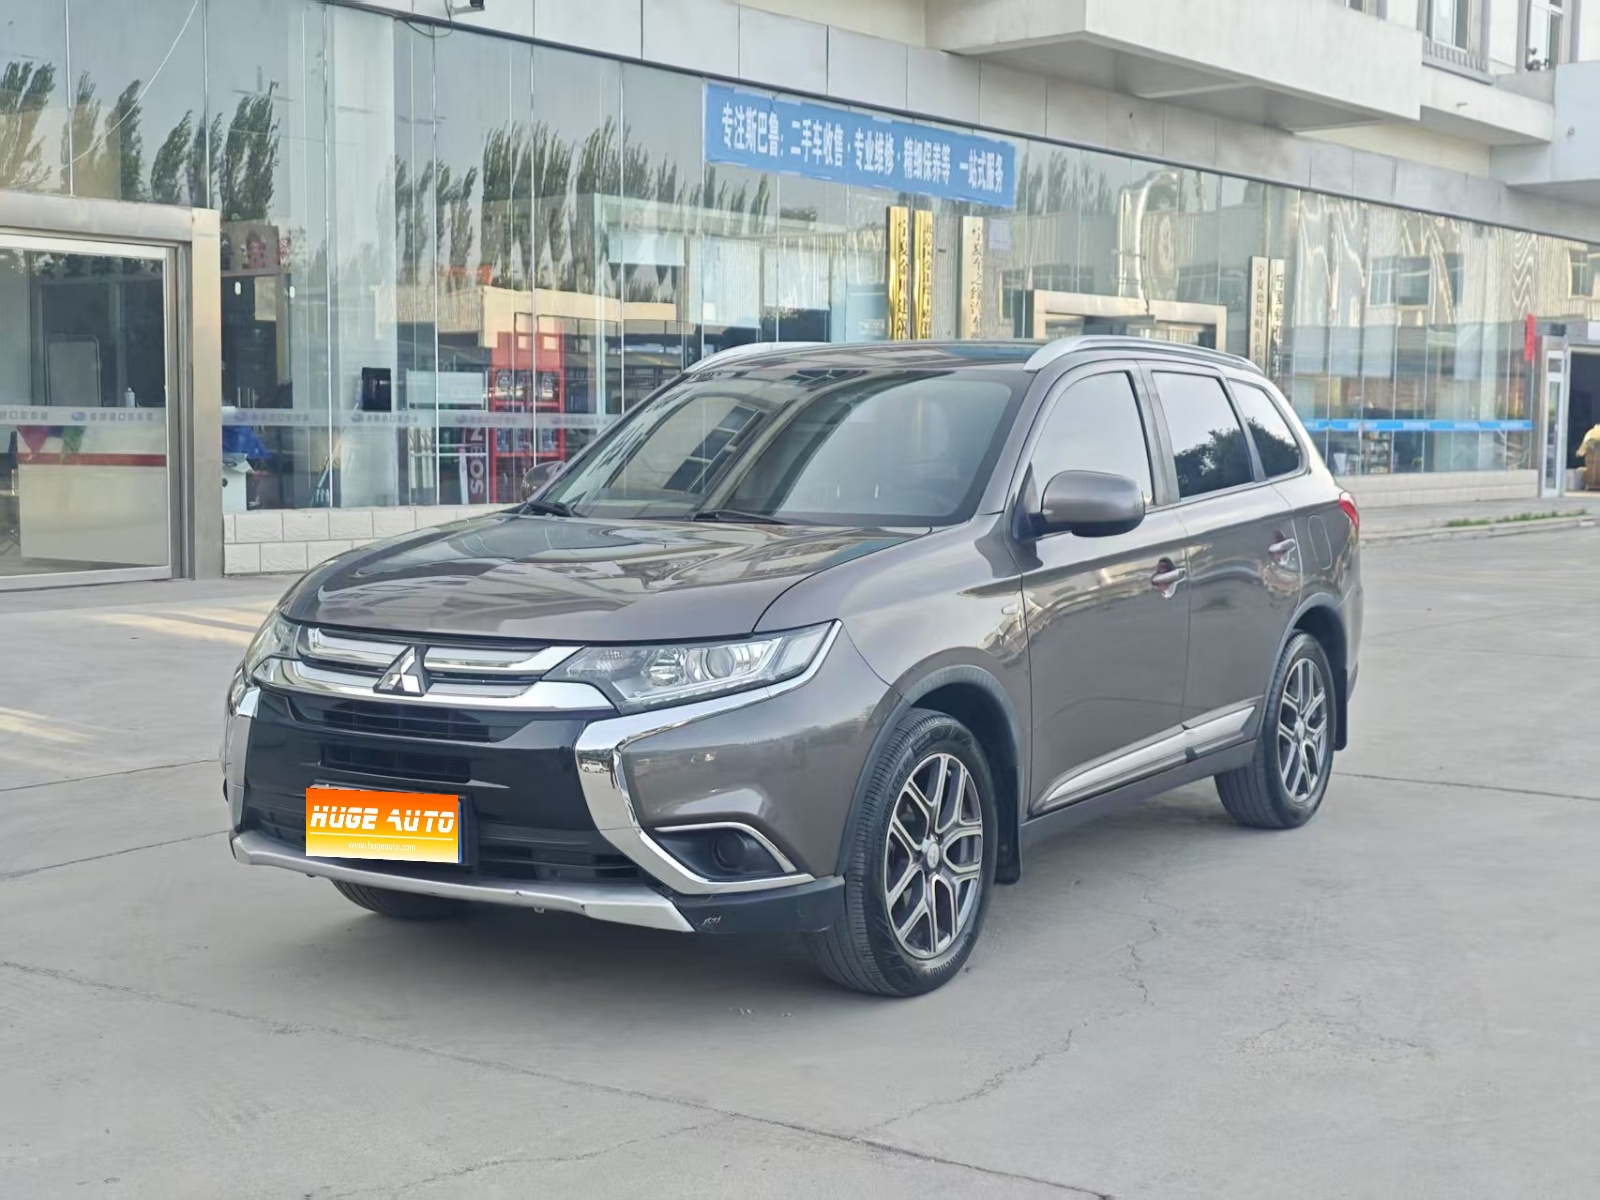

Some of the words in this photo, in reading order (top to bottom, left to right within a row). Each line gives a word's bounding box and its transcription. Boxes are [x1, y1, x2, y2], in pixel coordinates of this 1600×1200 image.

[959, 149, 1003, 193] 一站式服务
[469, 426, 484, 494] NEOS
